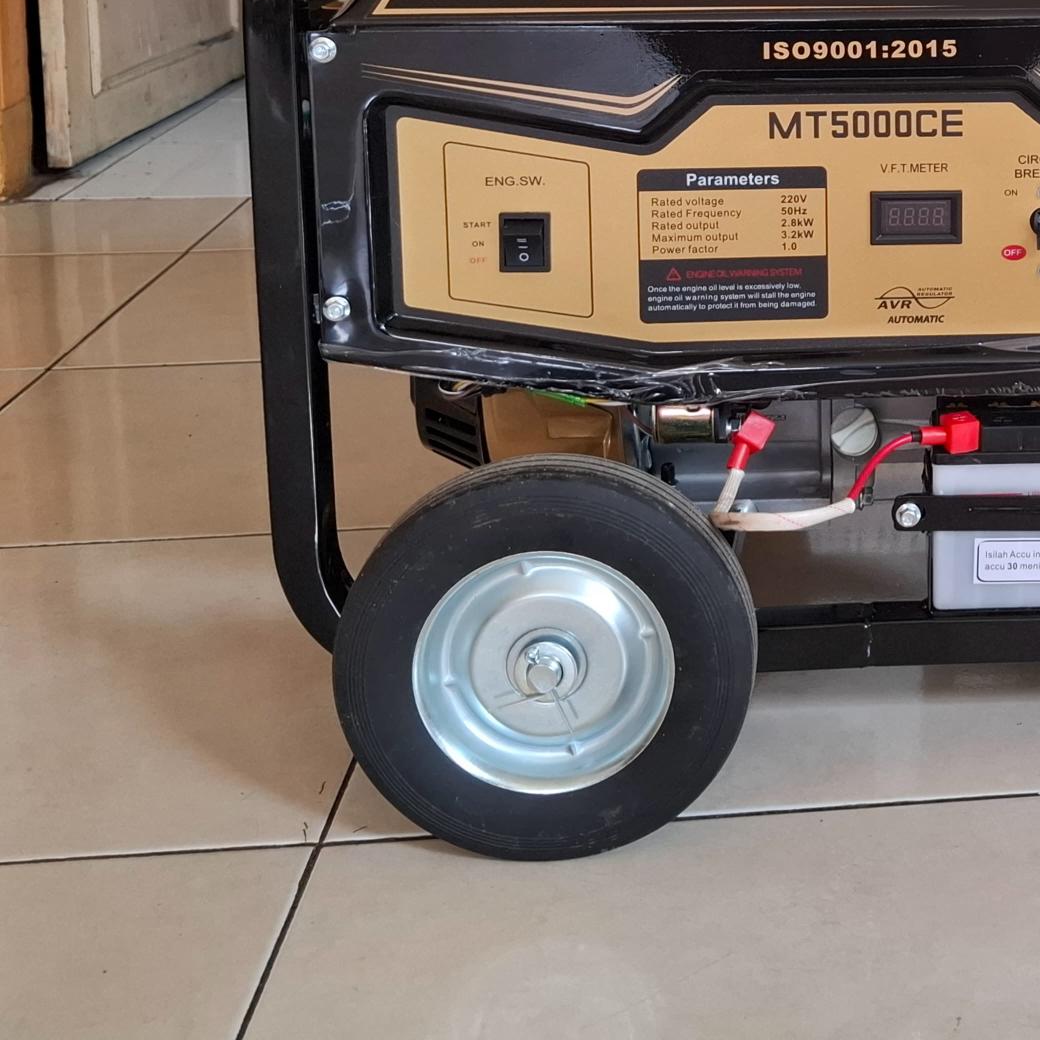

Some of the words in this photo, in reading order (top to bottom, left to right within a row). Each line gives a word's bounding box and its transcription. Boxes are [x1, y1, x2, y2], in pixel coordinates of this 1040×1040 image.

[762, 39, 958, 60] ISO9001:2015
[768, 109, 963, 139] MT5000CE
[880, 163, 949, 174] V.F.T.METER
[485, 176, 546, 187] ENG.SW.
[686, 173, 780, 187] Parameters
[1004, 189, 1018, 197] ON
[651, 197, 683, 207] Rated
[686, 197, 724, 208] voltage
[780, 195, 808, 204] 220V
[651, 209, 683, 218] Rated
[686, 209, 742, 220] Frequency
[781, 207, 808, 216] 50Hz
[651, 221, 683, 230] Rated
[686, 221, 720, 232] output
[781, 218, 814, 227] 2.8kW
[652, 233, 703, 243] Maximum
[705, 232, 739, 243] output
[781, 230, 814, 239] 3.2kW
[652, 245, 685, 254] Power
[688, 245, 718, 254] factor
[782, 242, 797, 251] 1.0
[1003, 248, 1023, 256] OFF
[647, 285, 667, 293] Once
[682, 284, 706, 293] engine
[744, 282, 786, 292] excessively
[647, 295, 673, 303] engine
[685, 293, 718, 302] warning
[720, 293, 746, 301] system
[790, 292, 816, 300] engine
[647, 303, 698, 312] automatically
[707, 302, 733, 311] protect
[740, 301, 757, 309] from
[758, 301, 778, 310] being
[877, 300, 912, 309] AVR
[887, 315, 945, 324] AUTOMATIC
[985, 551, 1008, 559] Isilah
[1009, 551, 1031, 559] Accu
